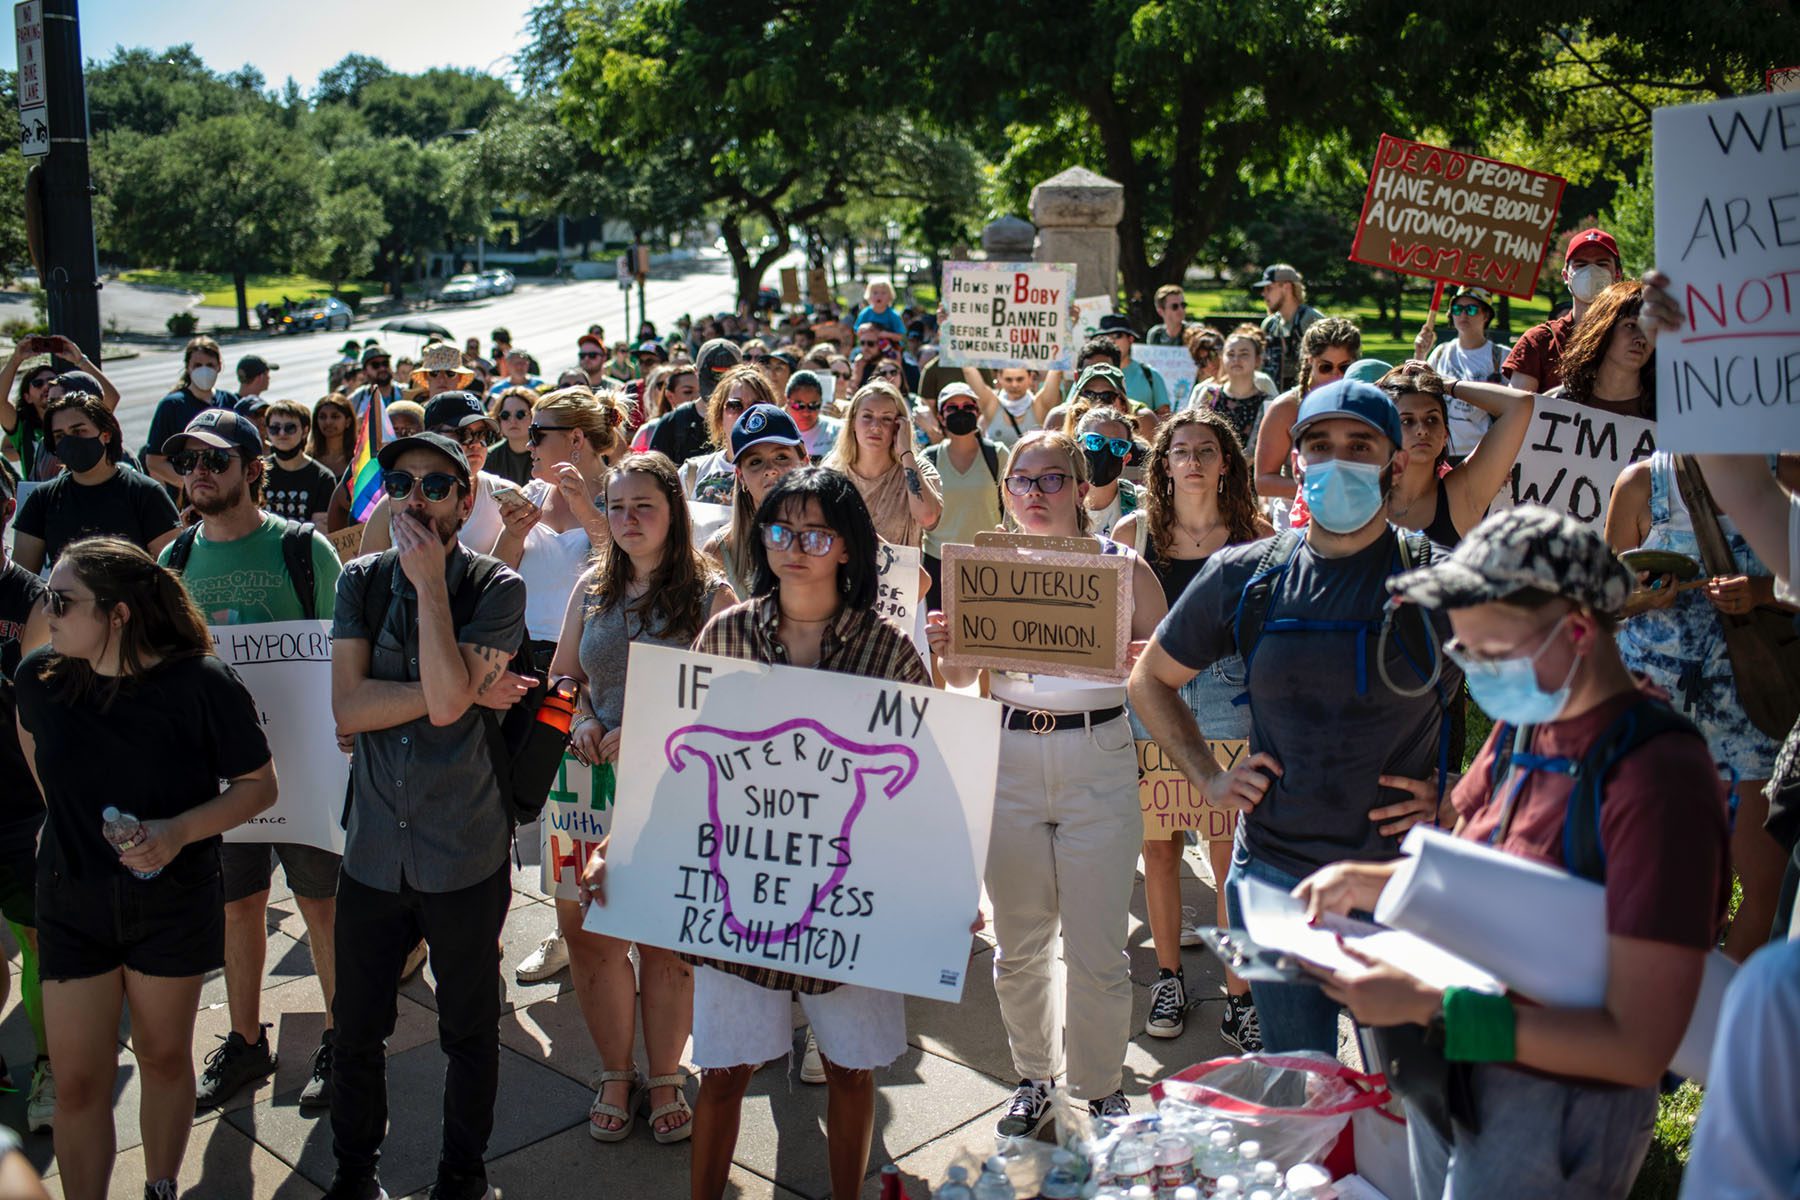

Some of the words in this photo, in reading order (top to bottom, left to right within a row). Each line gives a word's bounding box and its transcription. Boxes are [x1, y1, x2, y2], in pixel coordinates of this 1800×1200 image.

[1708, 105, 1800, 155] WE
[1383, 140, 1466, 181] DEAD
[1467, 160, 1548, 197] PEOPLE
[1373, 168, 1434, 206] HAVE
[1433, 185, 1493, 216] MORE
[1493, 196, 1554, 230] BODILY
[1365, 200, 1487, 248] AUTONOMY
[1492, 230, 1544, 263] THAN
[1681, 193, 1800, 262] ARE
[1388, 238, 1522, 291] WOMEN!
[951, 302, 989, 314] BEING
[992, 297, 1058, 327] BANNED
[995, 284, 1012, 295] MY
[1686, 270, 1800, 332] NOT
[949, 325, 989, 338] BEFORE
[995, 328, 1003, 339] A
[1010, 328, 1039, 344] GUN
[1046, 331, 1056, 343] IN
[1010, 344, 1059, 360] HAND?
[1532, 411, 1618, 462] I'M
[960, 565, 998, 597] NO
[231, 632, 333, 661] HYPOCRI
[962, 613, 997, 641] NO
[1012, 619, 1101, 649] OPINION.
[677, 663, 713, 710] IF
[867, 689, 929, 739] MY
[716, 732, 853, 783] UTERUS
[551, 811, 603, 835] With
[744, 785, 819, 820] SHOT
[1156, 812, 1203, 828] TINY
[698, 822, 853, 868] BULLETS
[753, 872, 791, 906] BE
[810, 882, 875, 917] LESS
[678, 906, 861, 971] REGULATED!
